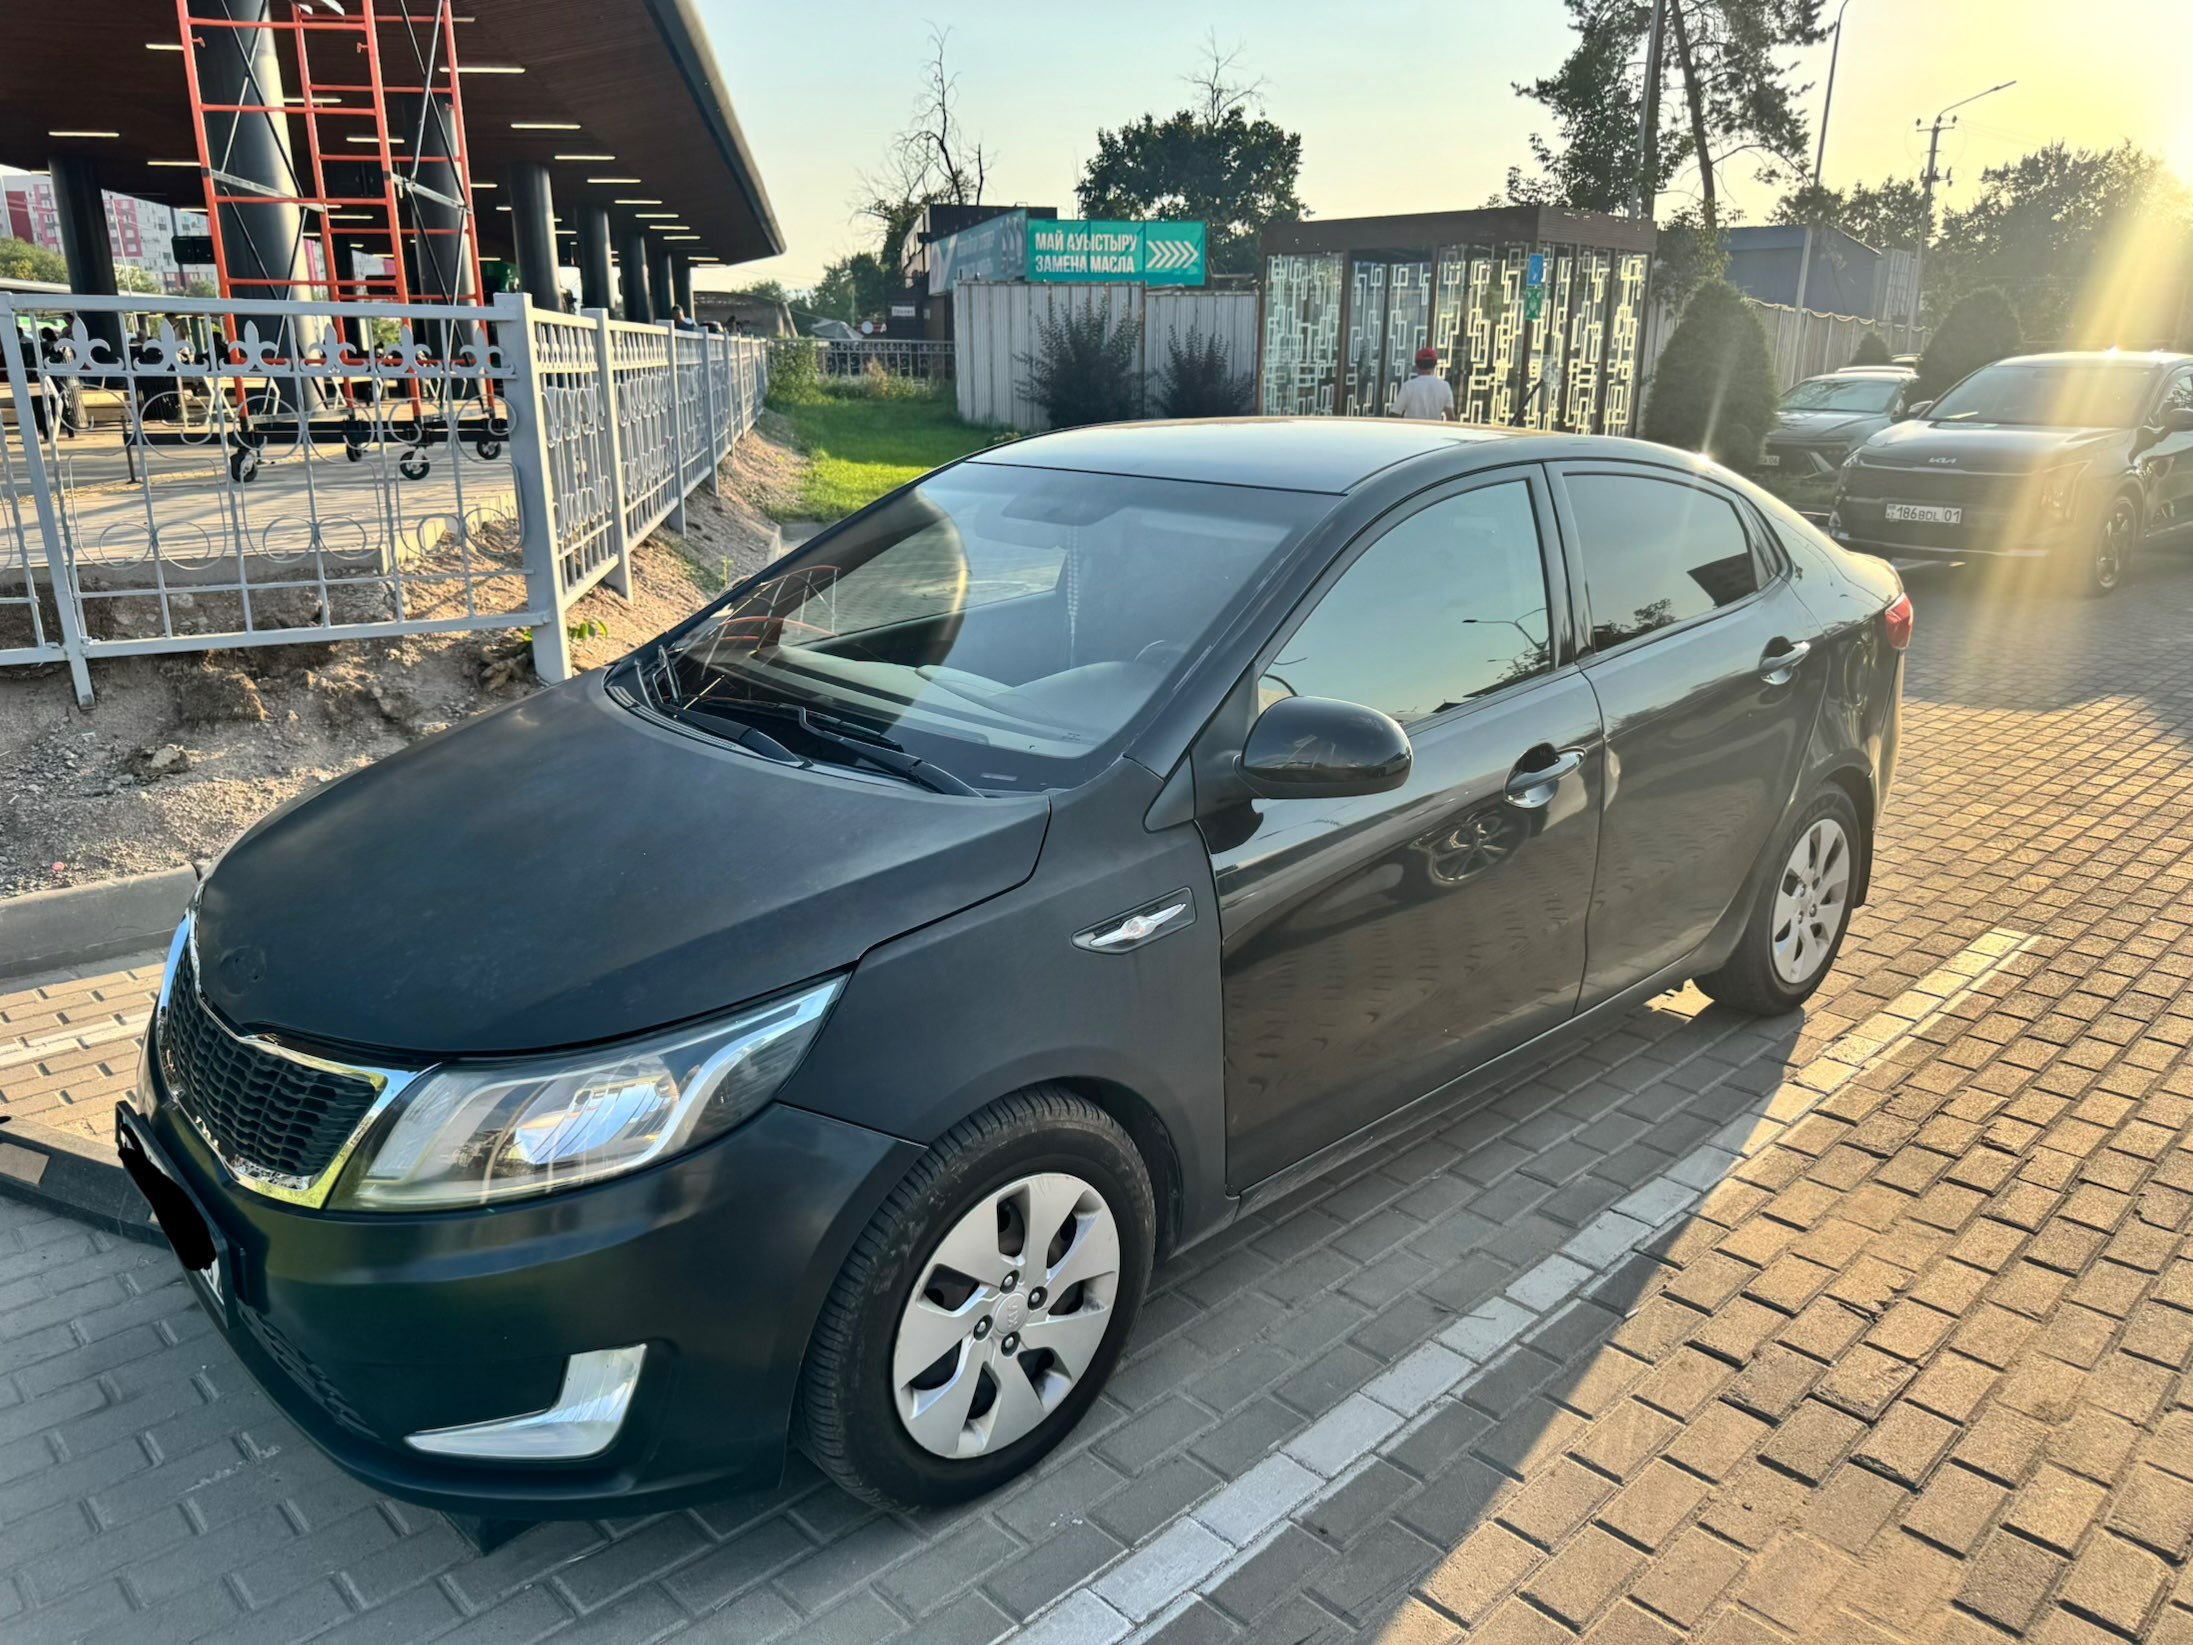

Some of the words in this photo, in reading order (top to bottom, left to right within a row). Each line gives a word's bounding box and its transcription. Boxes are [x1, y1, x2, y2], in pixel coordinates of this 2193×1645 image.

[1035, 229, 1064, 251] МАЙ
[1067, 233, 1138, 252] АУЫСТЫРУ
[1035, 254, 1088, 273] ЗАМЕНА
[1090, 255, 1136, 273] МАСЛА
[1944, 510, 1960, 522] 01
